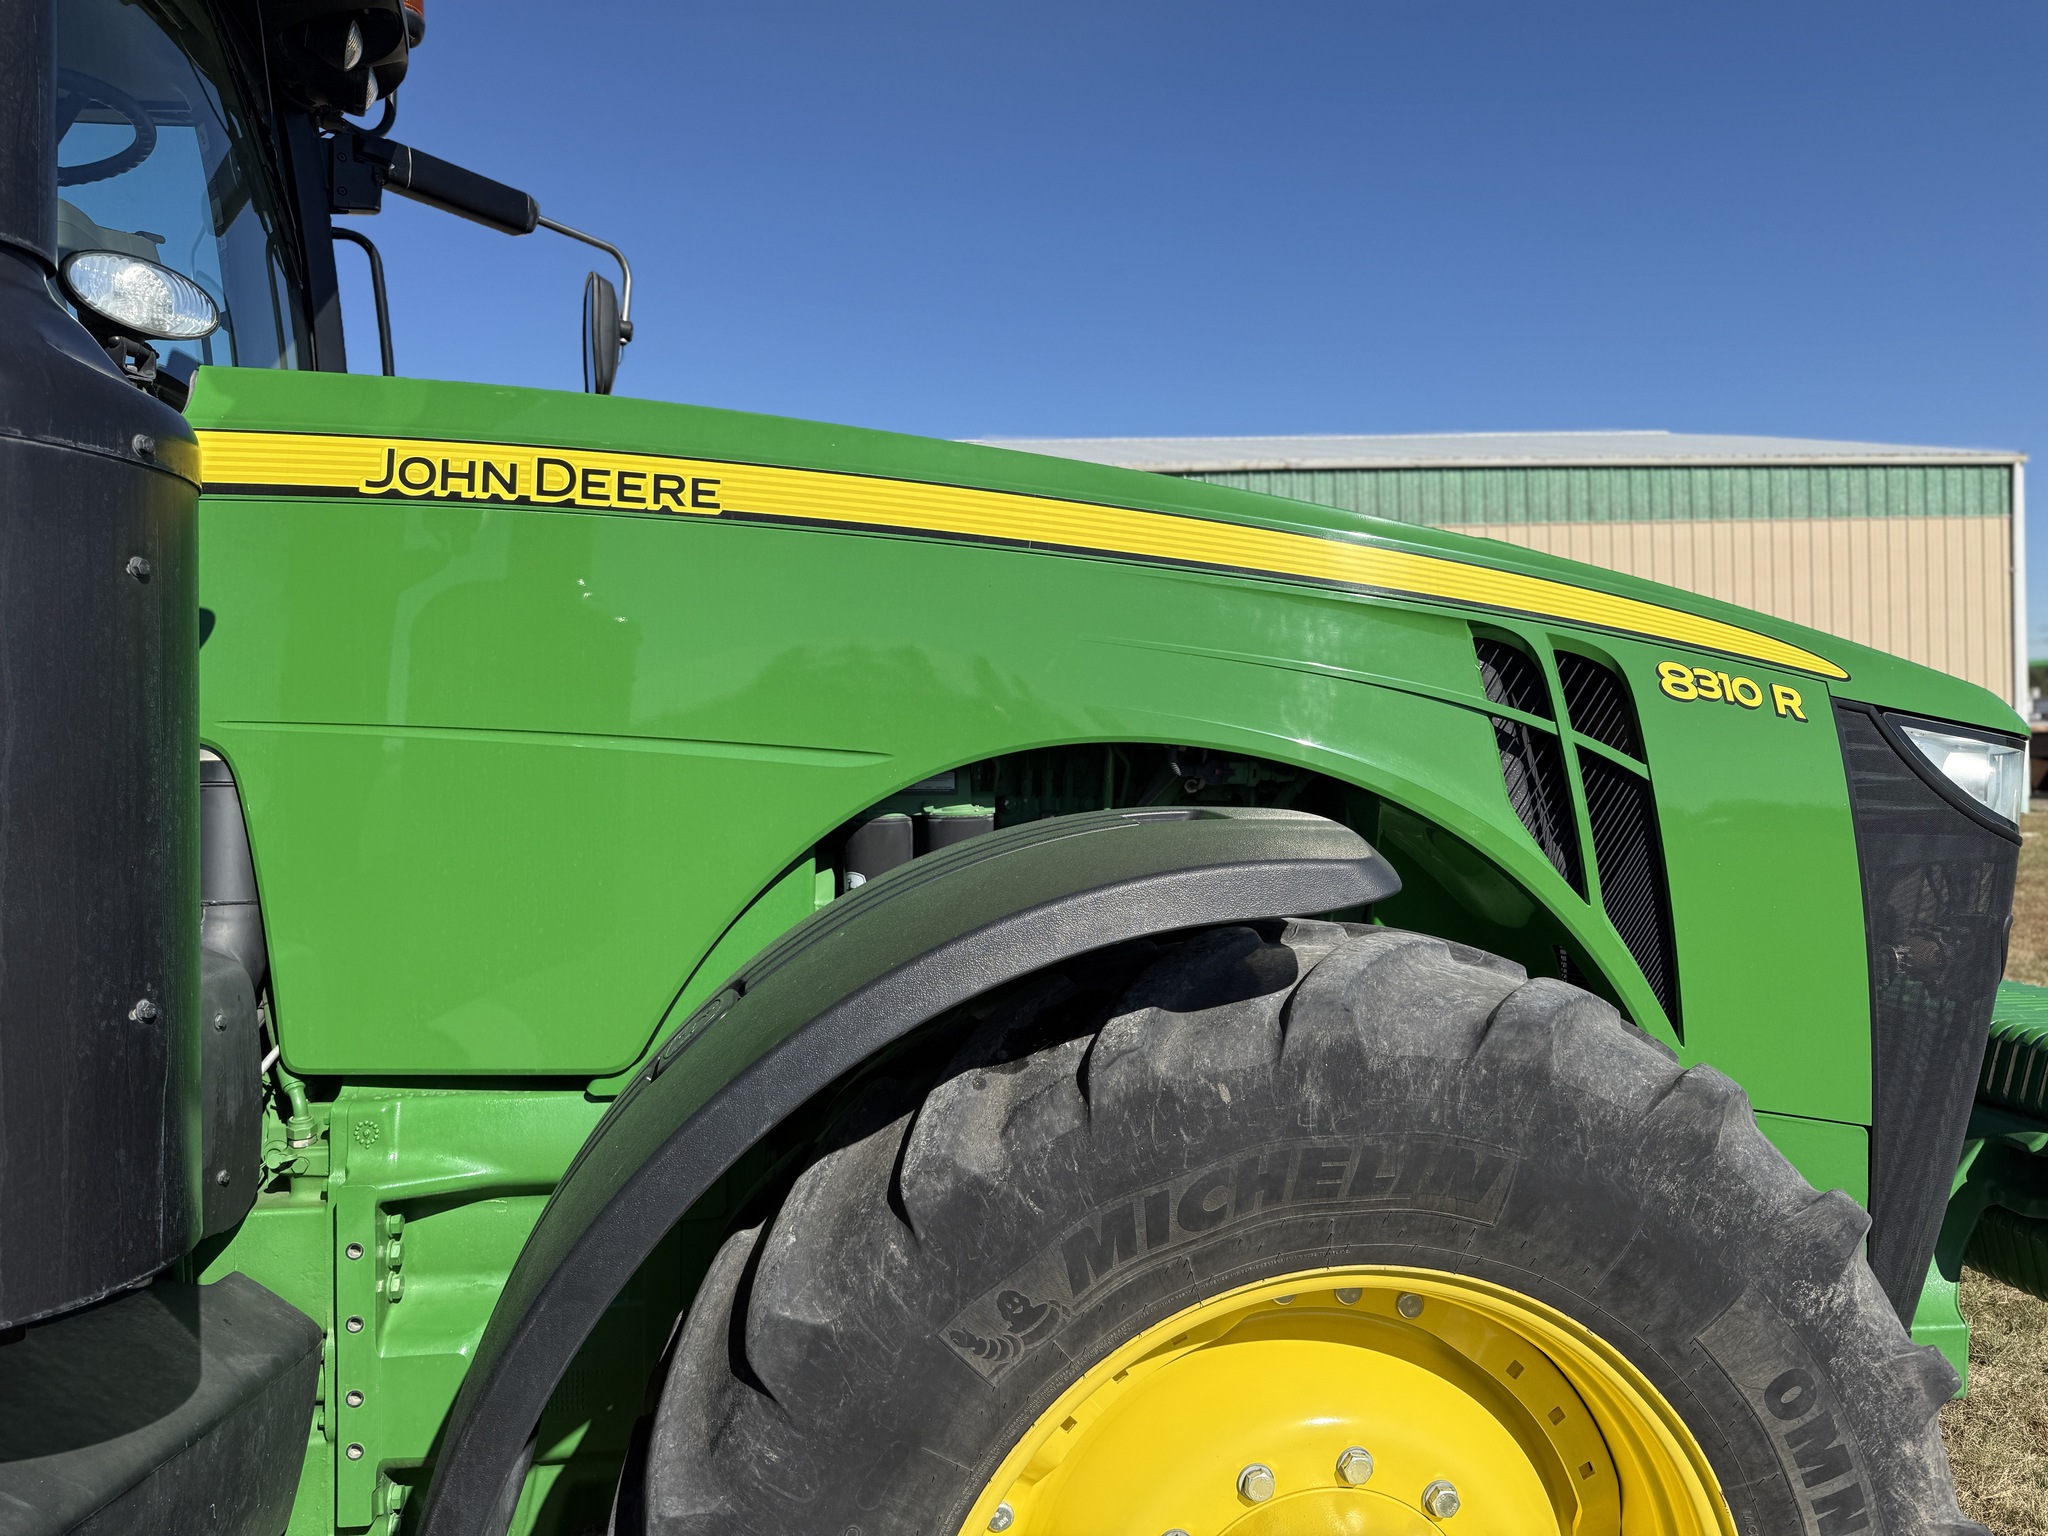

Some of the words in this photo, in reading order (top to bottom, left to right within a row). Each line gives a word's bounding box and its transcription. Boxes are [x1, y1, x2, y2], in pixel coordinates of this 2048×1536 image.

[364, 447, 518, 496] JOHN
[535, 456, 722, 511] DEERE
[1656, 660, 1763, 710] 8310
[1769, 683, 1808, 723] R
[1061, 1142, 1509, 1298] MICHELIN
